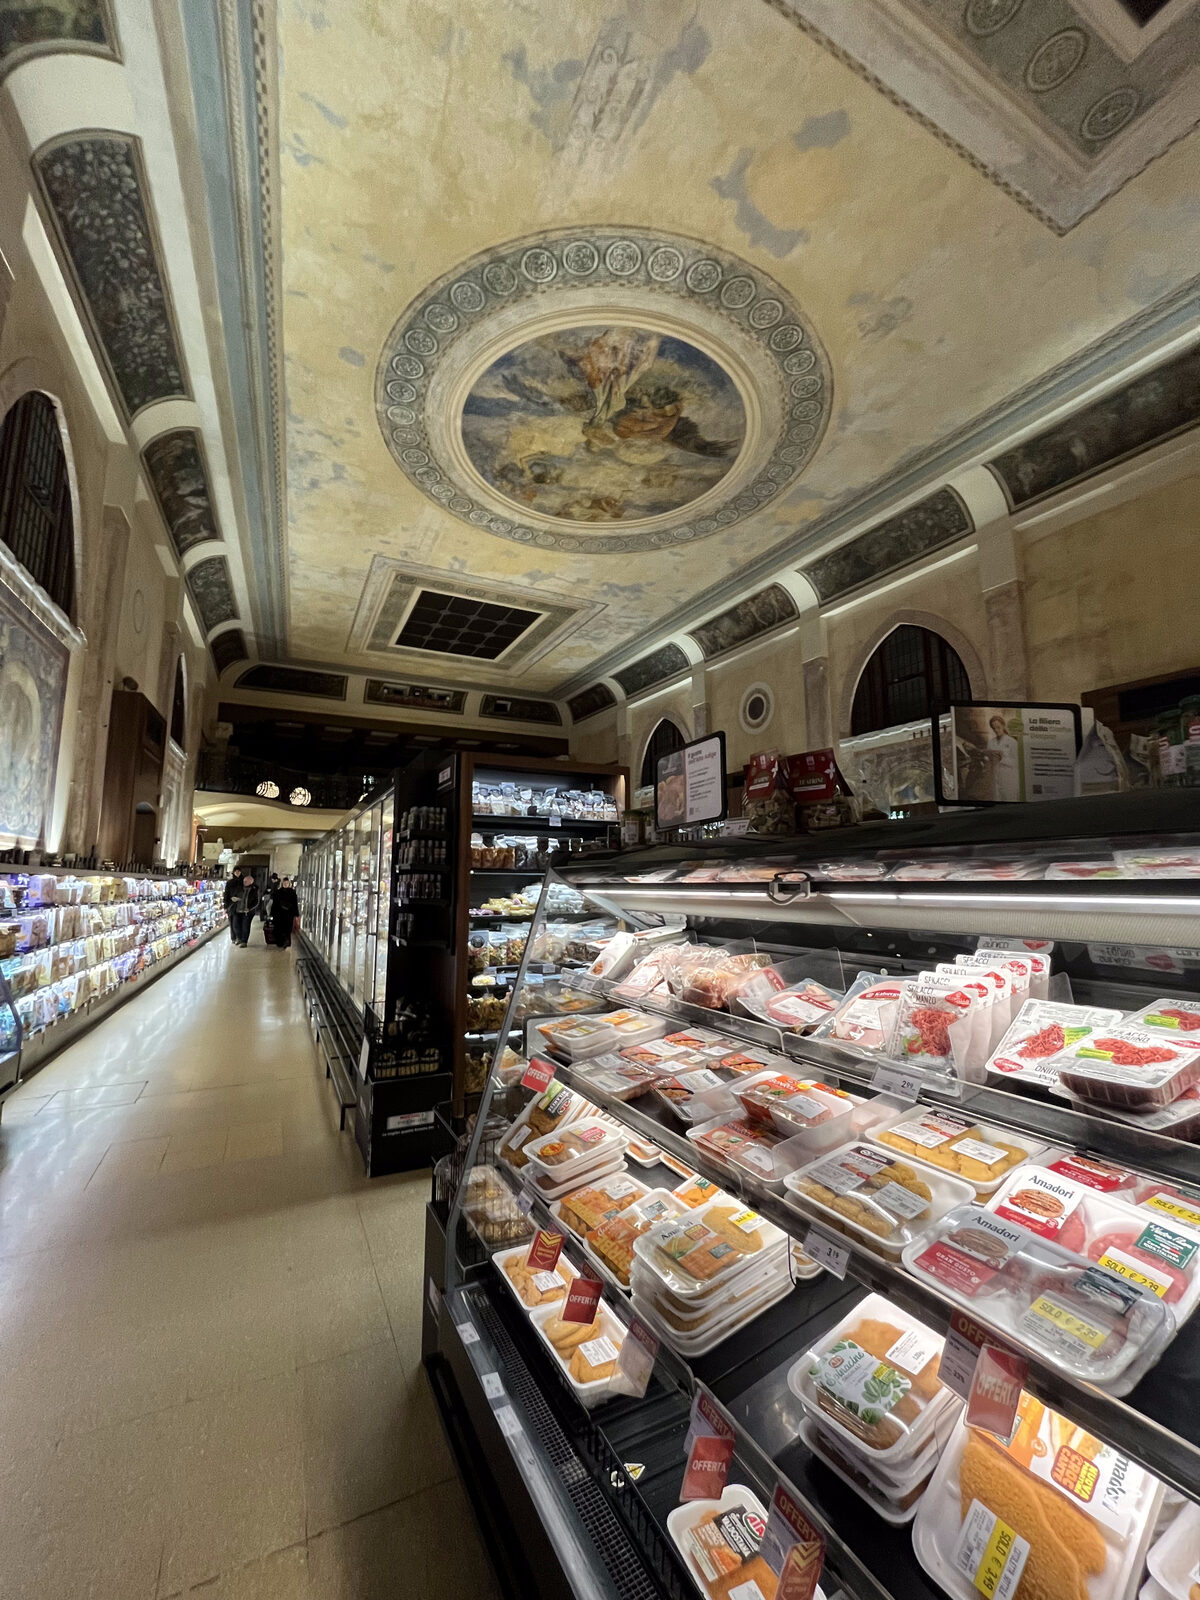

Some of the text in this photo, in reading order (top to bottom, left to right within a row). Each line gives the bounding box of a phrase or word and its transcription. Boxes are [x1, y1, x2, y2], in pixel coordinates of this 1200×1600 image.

[915, 994, 937, 1005] MANZO
[526, 1067, 549, 1083] OFFERTA
[1028, 1174, 1075, 1199] Amadori
[1153, 1199, 1175, 1210] SOLO
[971, 1216, 1021, 1242] Amadori
[935, 1251, 954, 1264] GRAN
[954, 1262, 976, 1277] GUSTO
[1104, 1259, 1159, 1293] SOLO € 2,39
[569, 1294, 597, 1306] OFFERTA
[1039, 1303, 1098, 1339] SOLO € 2,39
[692, 1459, 727, 1473] OFFERTA
[1061, 1453, 1084, 1489] CROC
[1080, 1463, 1099, 1501] NUOVA
[746, 1515, 766, 1538] AIA
[779, 1495, 820, 1544] OFFERT
[721, 1515, 750, 1558] VALDOSTANA
[983, 1530, 1012, 1591] SOLO € 3,49
